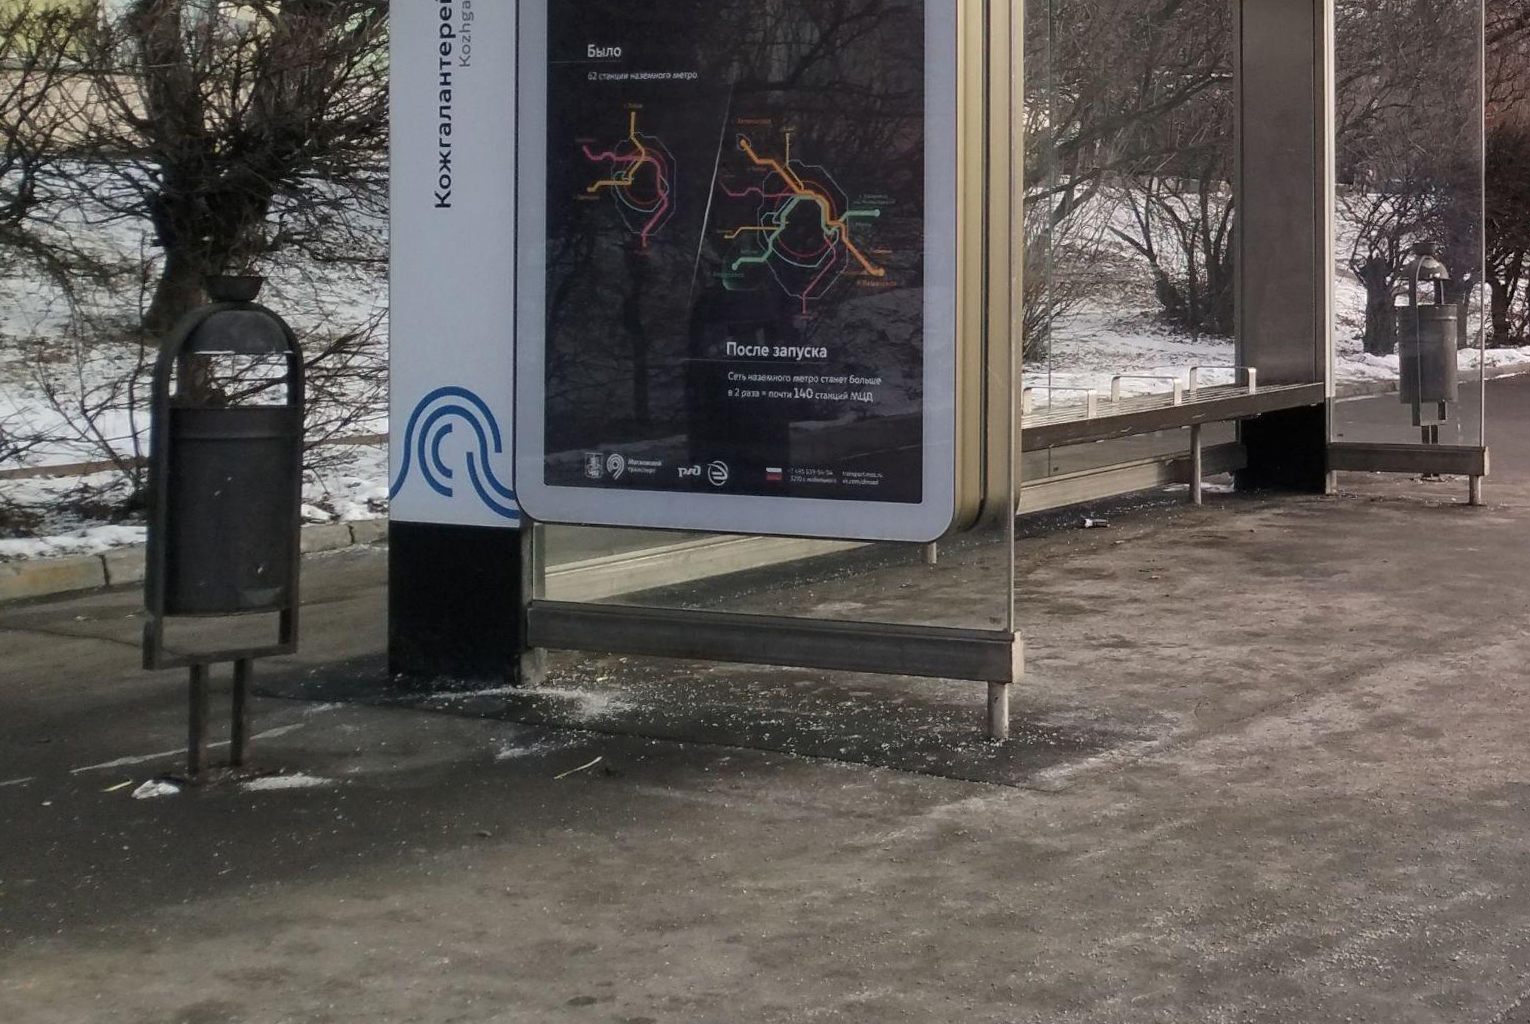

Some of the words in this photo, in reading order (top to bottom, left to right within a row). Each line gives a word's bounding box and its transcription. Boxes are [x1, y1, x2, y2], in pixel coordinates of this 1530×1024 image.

[587, 43, 622, 58] Было
[726, 341, 770, 357] После
[773, 345, 828, 361] запуска
[727, 371, 747, 381] Сеть
[792, 375, 819, 384] метро
[848, 374, 882, 386] больше
[793, 387, 814, 399] 140
